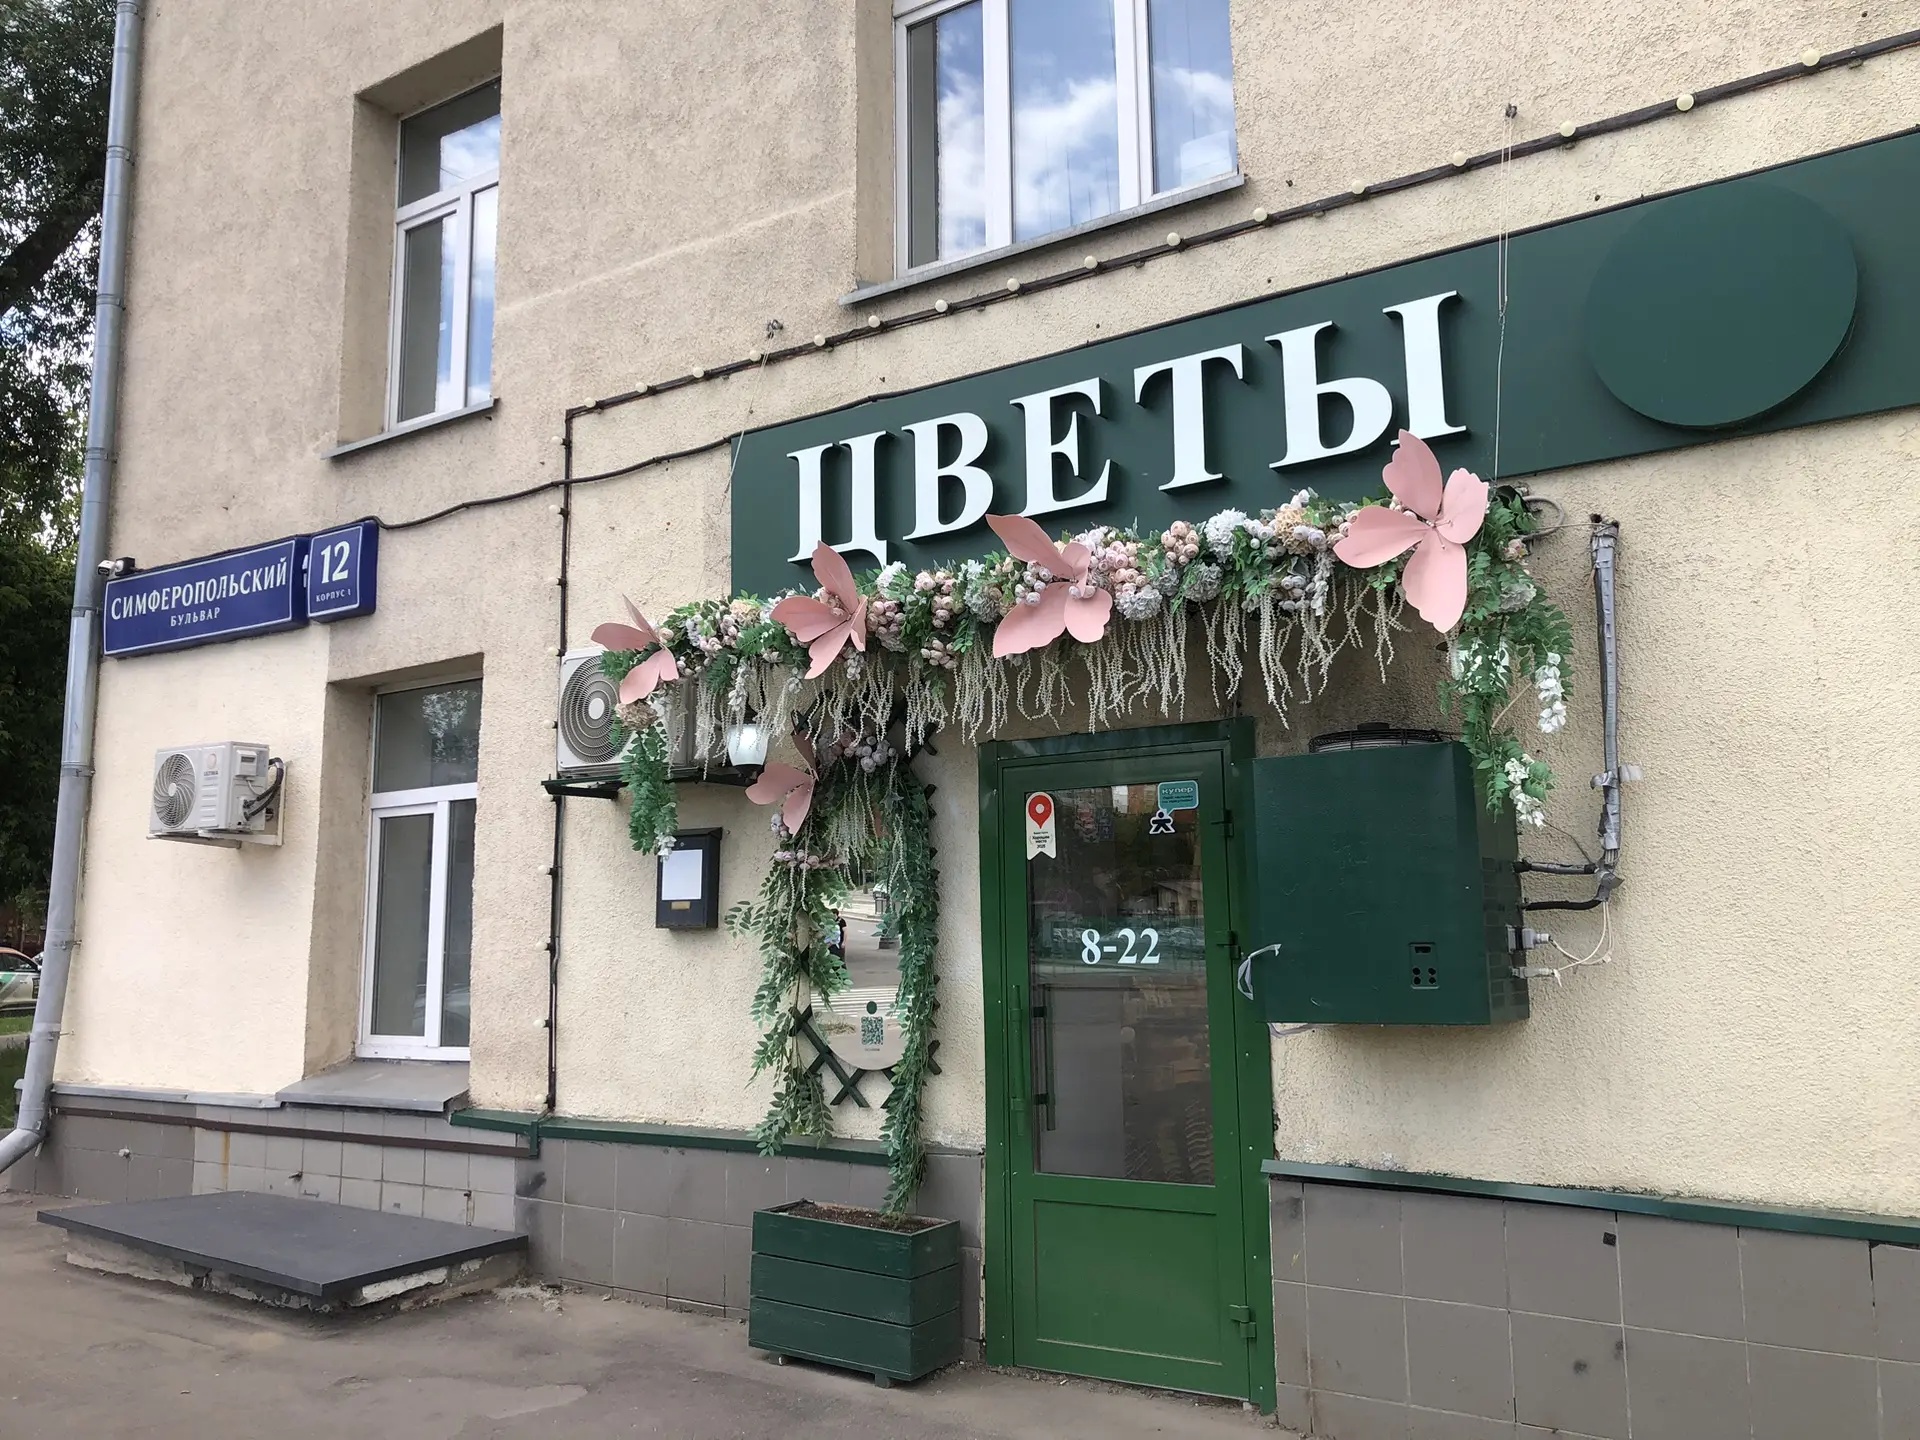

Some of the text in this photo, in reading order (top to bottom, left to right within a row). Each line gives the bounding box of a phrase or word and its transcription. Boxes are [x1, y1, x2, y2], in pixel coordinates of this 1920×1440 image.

[787, 291, 1467, 567] ЦВЕТЫ
[320, 540, 350, 584] 12
[111, 556, 287, 620] СИМФЕРОПОЛЬСКИЙ
[315, 589, 345, 602] КОРПУС
[170, 607, 221, 627] БУЛЬВАР
[1162, 787, 1193, 795] купер
[1081, 928, 1160, 965] 8-22
